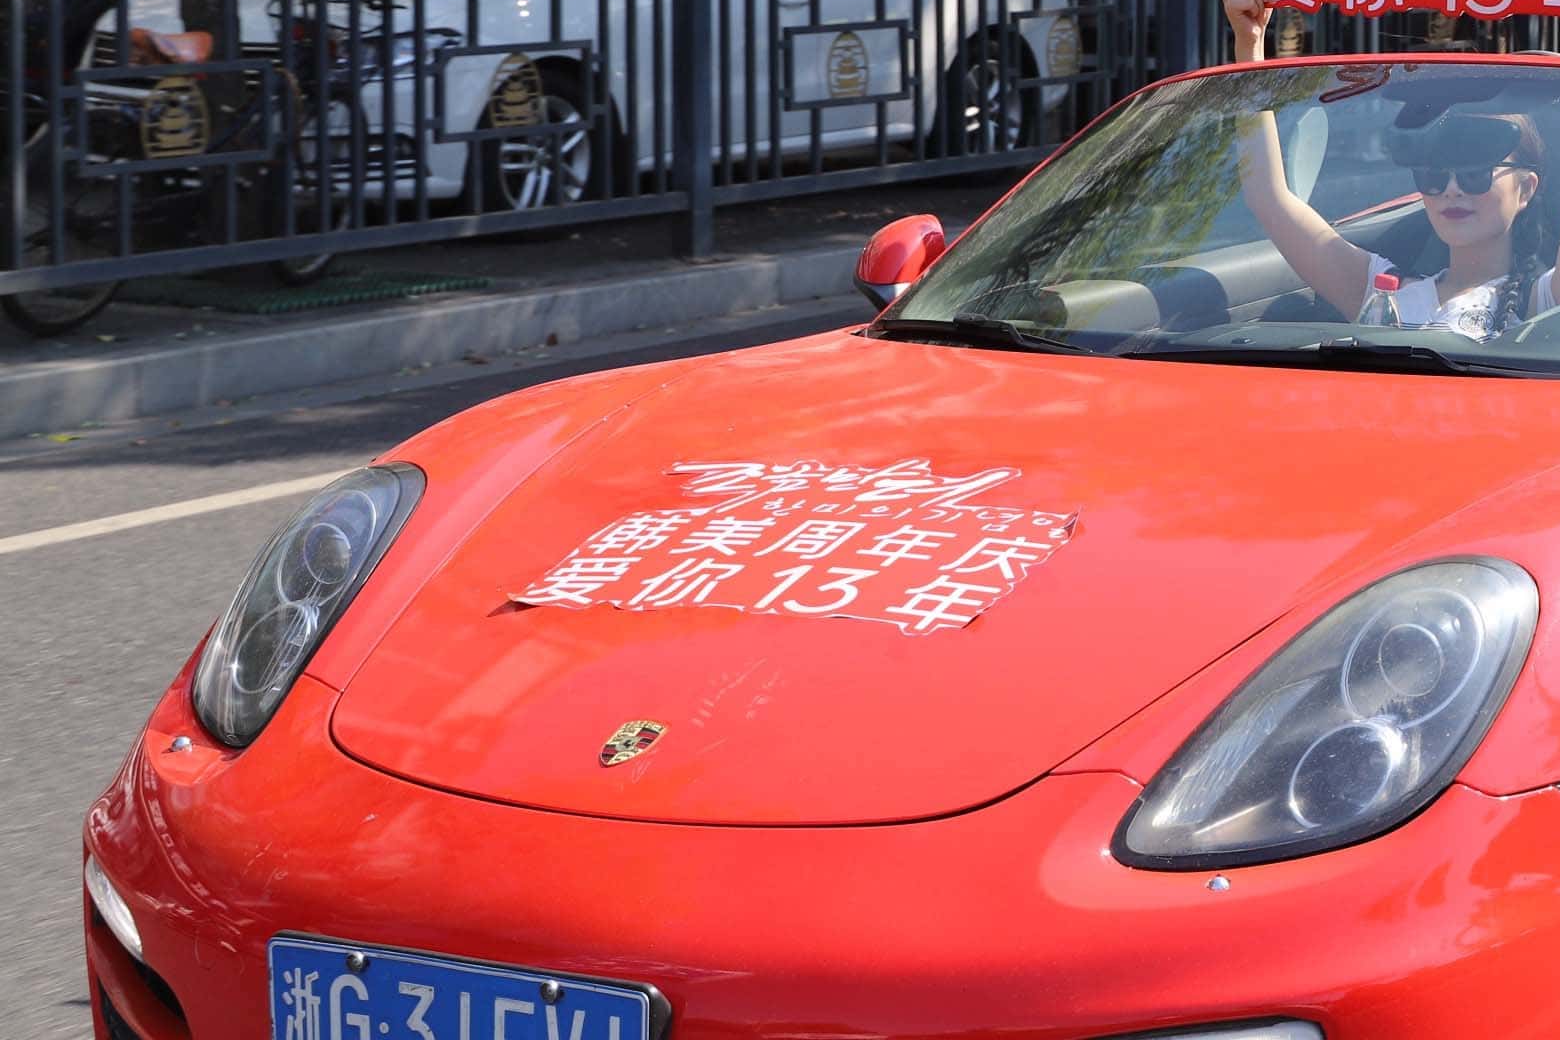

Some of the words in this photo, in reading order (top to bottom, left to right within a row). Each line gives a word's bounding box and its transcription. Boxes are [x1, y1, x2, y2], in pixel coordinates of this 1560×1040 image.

[589, 512, 1052, 579] 韩美周年庆
